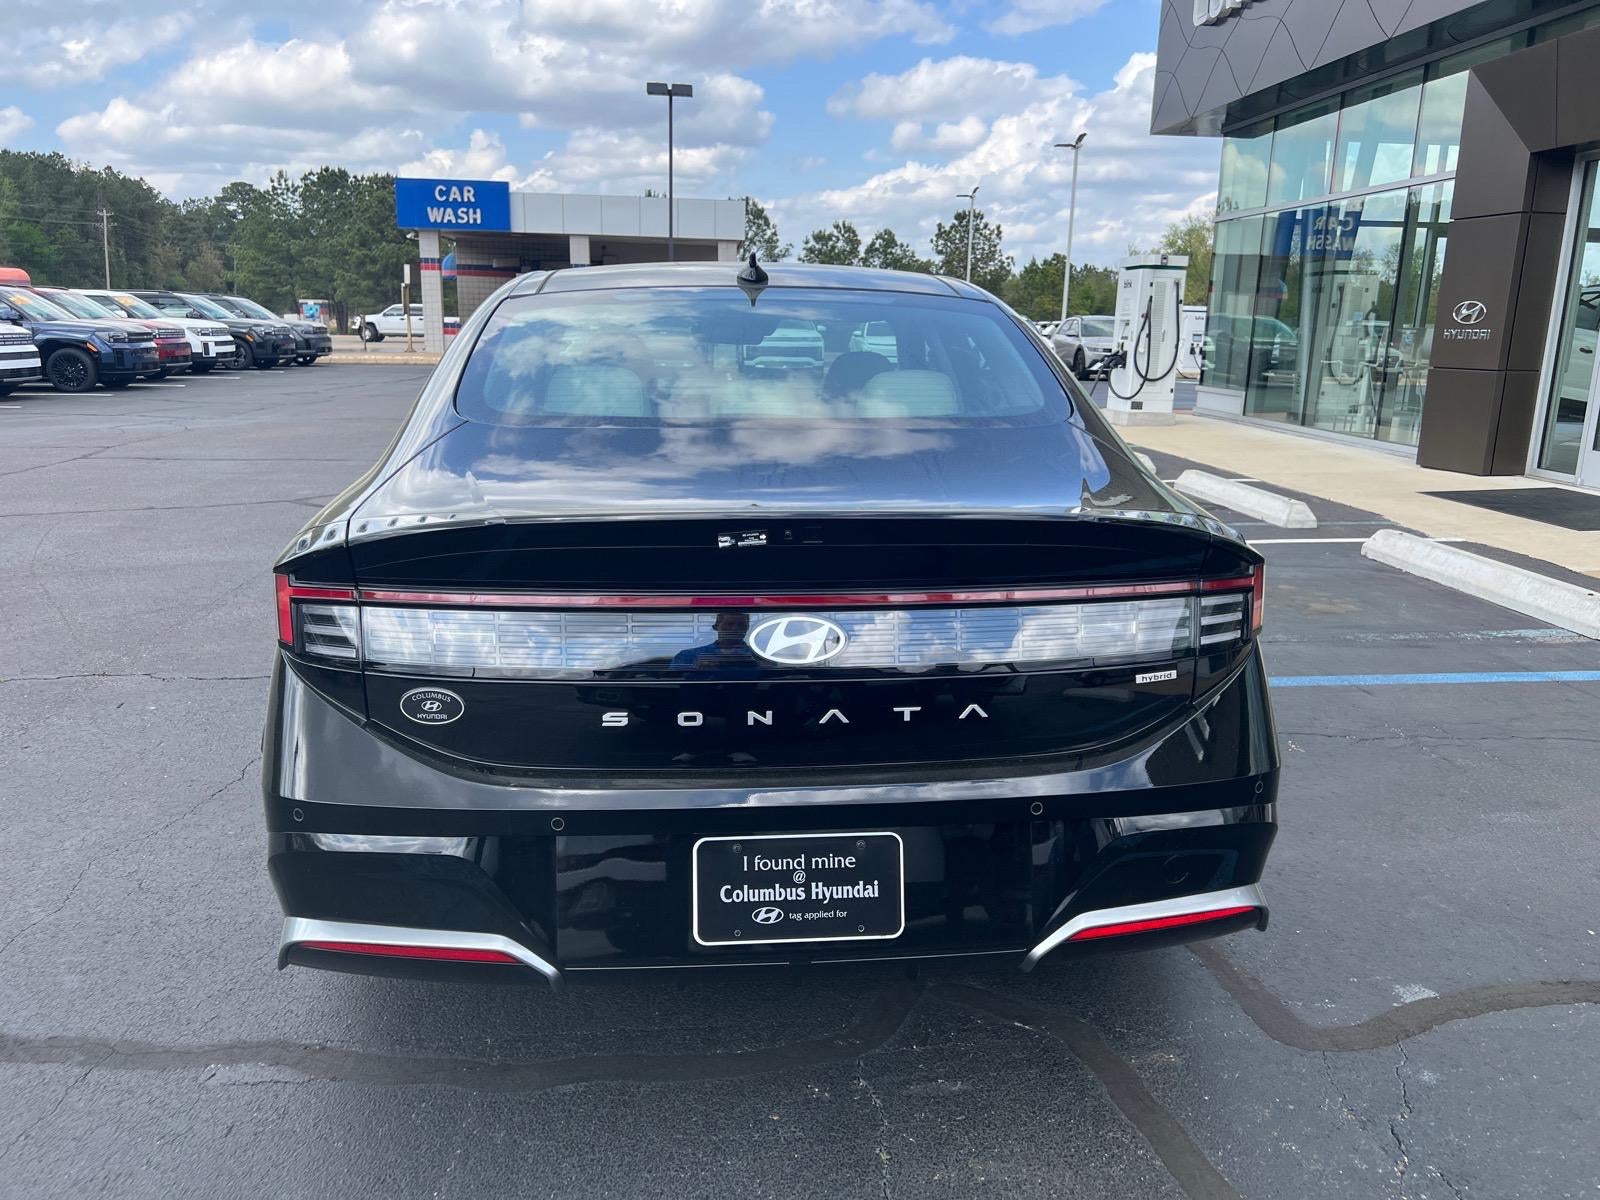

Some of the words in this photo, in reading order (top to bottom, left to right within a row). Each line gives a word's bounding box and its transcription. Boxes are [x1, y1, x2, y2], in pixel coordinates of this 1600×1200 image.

[434, 184, 475, 202] CAR
[427, 206, 482, 224] WASH
[1443, 328, 1491, 340] HYUNDAI
[1141, 672, 1172, 682] hybrid
[411, 692, 451, 702] COLUMBUS
[601, 703, 989, 727] SONATA
[743, 855, 748, 871] I
[754, 854, 805, 871] found
[811, 853, 856, 869] mine
[792, 870, 806, 884] @
[719, 883, 806, 903] Columbus
[811, 879, 879, 904] Hyundai
[789, 911, 802, 921] tag
[804, 910, 834, 920] applied
[836, 909, 848, 918] for
